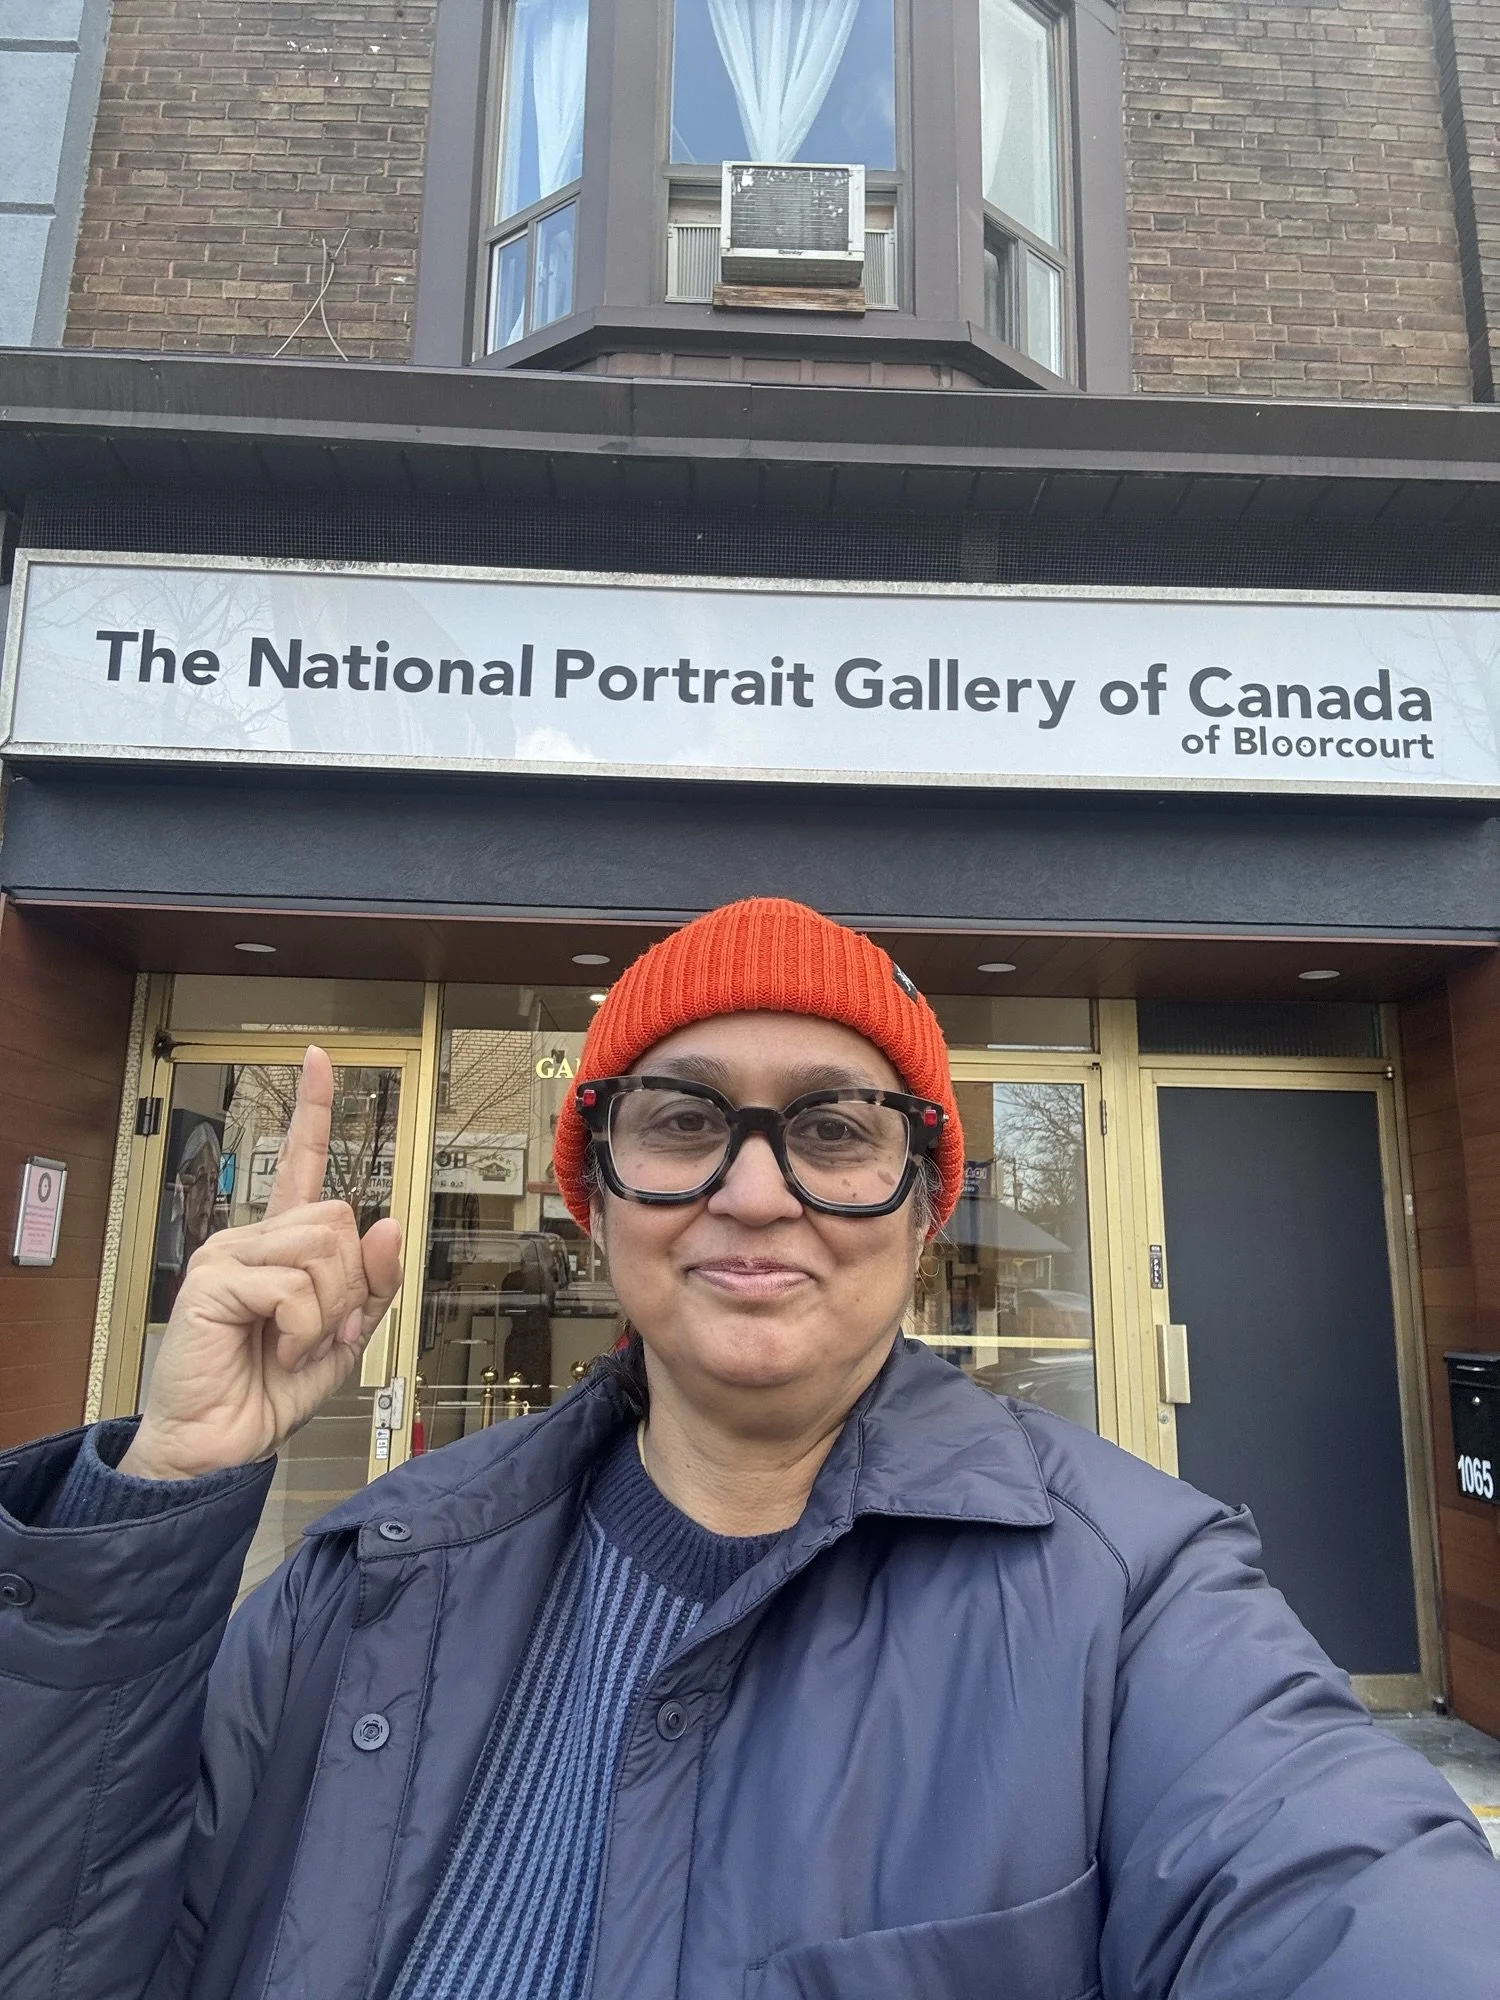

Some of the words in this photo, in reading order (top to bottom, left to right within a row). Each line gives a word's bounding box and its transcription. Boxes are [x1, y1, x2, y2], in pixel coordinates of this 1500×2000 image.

[95, 628, 220, 686] The
[248, 637, 534, 697] National
[555, 648, 814, 708] Portrait
[834, 657, 1076, 730] Gallery
[1099, 663, 1167, 716] of
[1189, 667, 1432, 722] Canada
[1181, 724, 1220, 755] of
[1233, 725, 1435, 760] Bloorcourt
[1457, 1454, 1494, 1499] 1065
